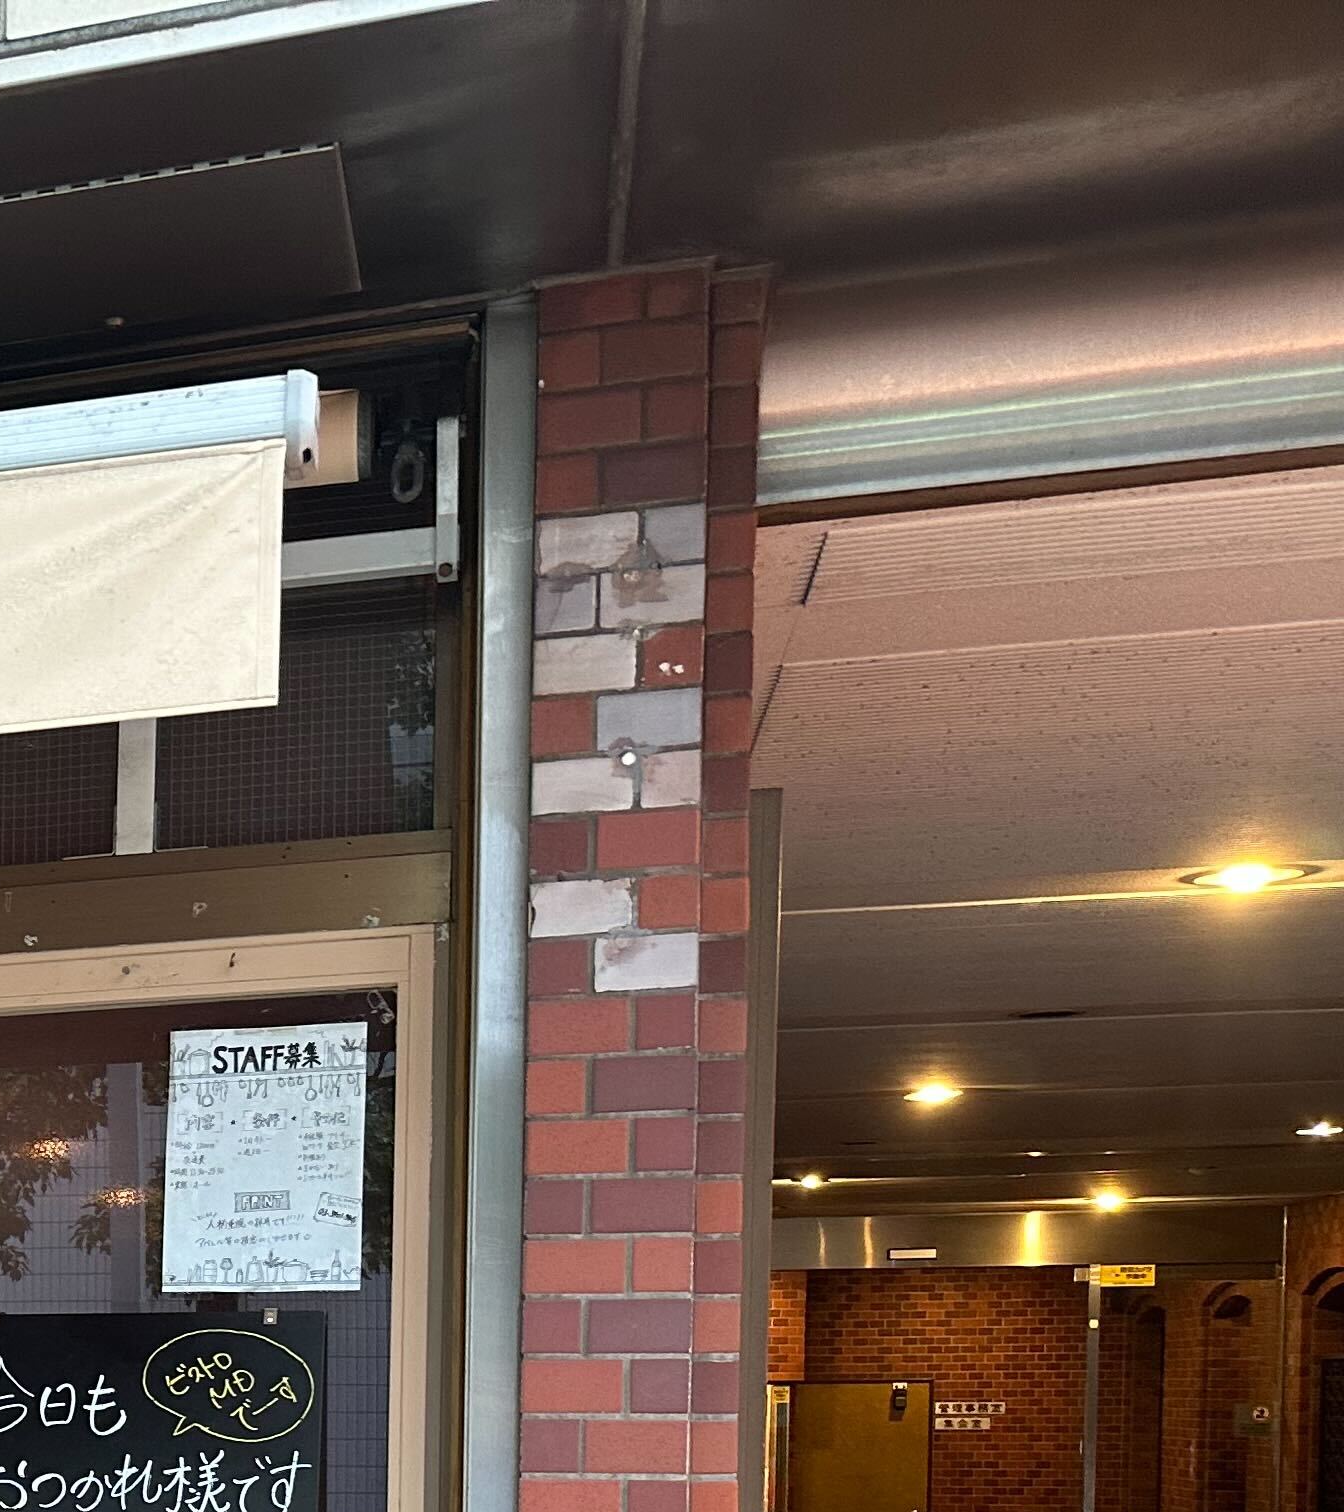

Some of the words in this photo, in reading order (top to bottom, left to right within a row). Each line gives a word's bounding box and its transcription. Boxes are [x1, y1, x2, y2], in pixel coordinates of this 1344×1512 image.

[212, 1041, 322, 1075] STAFF募集
[165, 1353, 232, 1395] ビストロ
